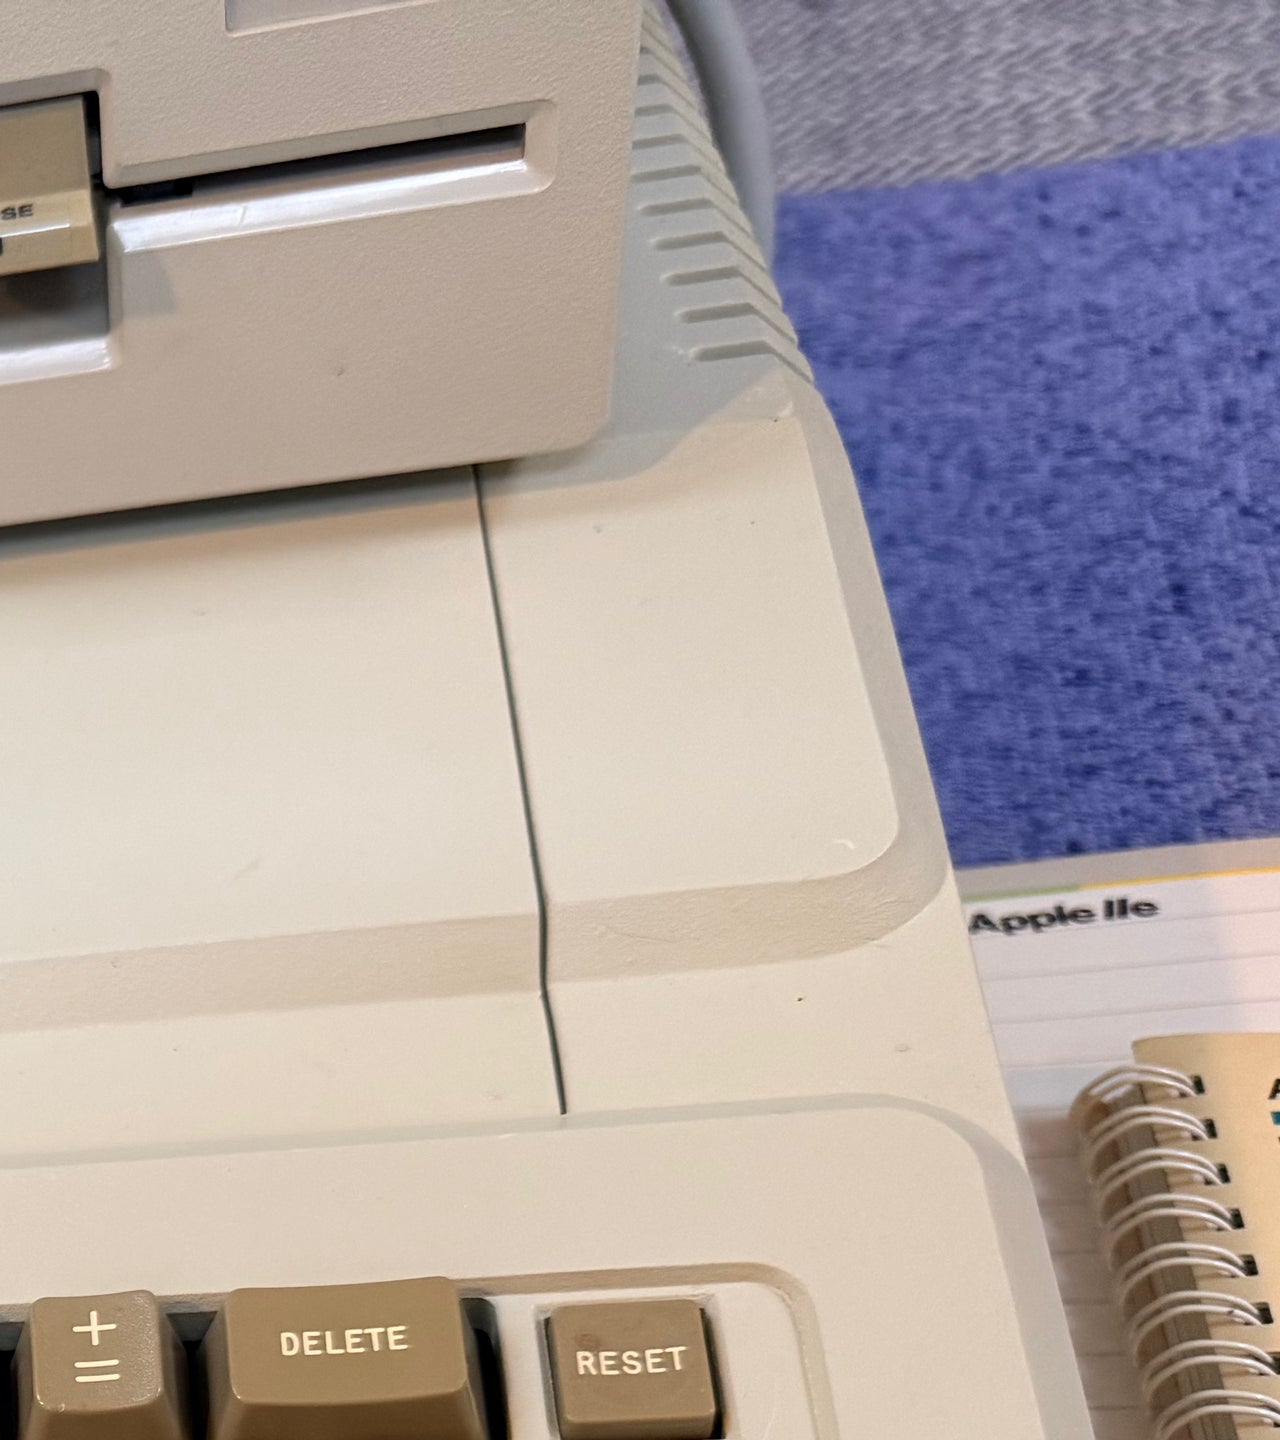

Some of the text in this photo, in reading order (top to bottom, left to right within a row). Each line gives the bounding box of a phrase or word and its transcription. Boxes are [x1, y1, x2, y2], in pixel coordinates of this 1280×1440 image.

[968, 904, 1096, 935] Apple
[280, 1325, 409, 1357] DELETE
[576, 1346, 688, 1375] RESET
